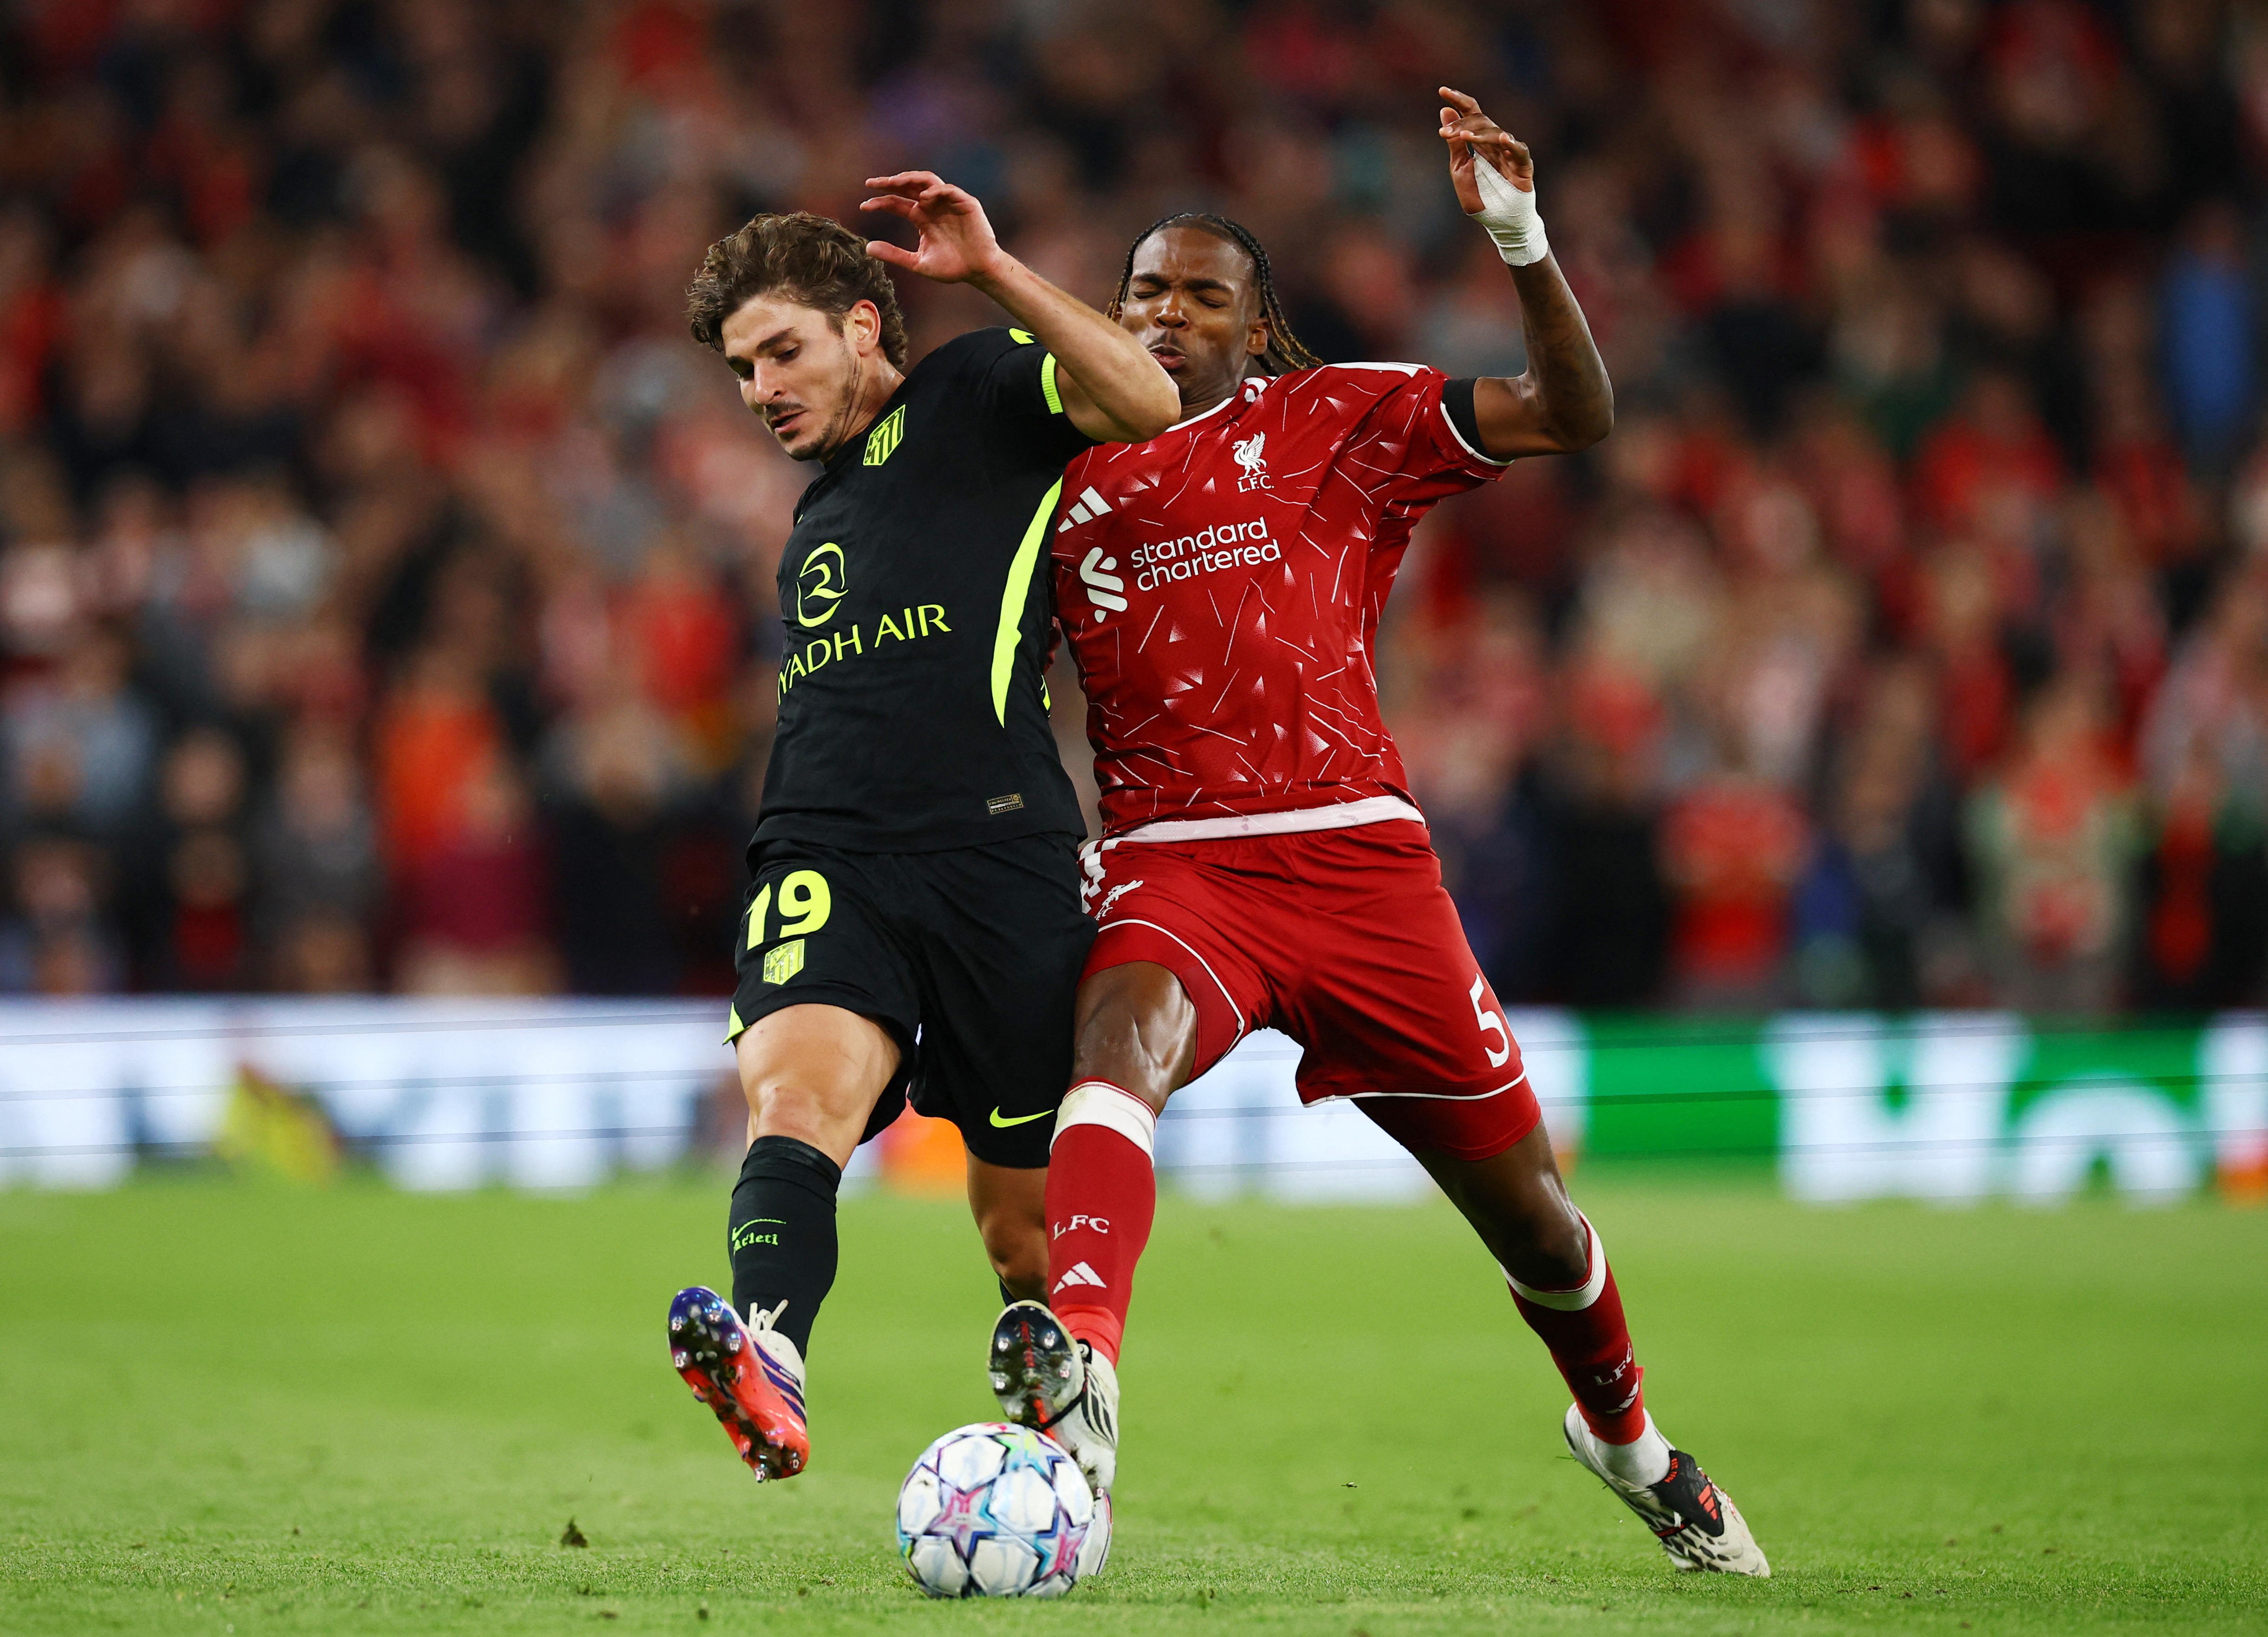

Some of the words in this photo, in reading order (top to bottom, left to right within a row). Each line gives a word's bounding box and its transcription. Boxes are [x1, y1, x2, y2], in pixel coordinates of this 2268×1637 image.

[1237, 475, 1275, 493] L.F.C.
[1131, 516, 1268, 568] standard
[1137, 539, 1282, 591] chartered
[777, 624, 862, 706] YADH
[875, 604, 952, 648] AIR
[745, 870, 831, 950] 19
[1469, 973, 1510, 1068] 5
[733, 1232, 779, 1256] Atleti
[1053, 1214, 1110, 1241] LFC
